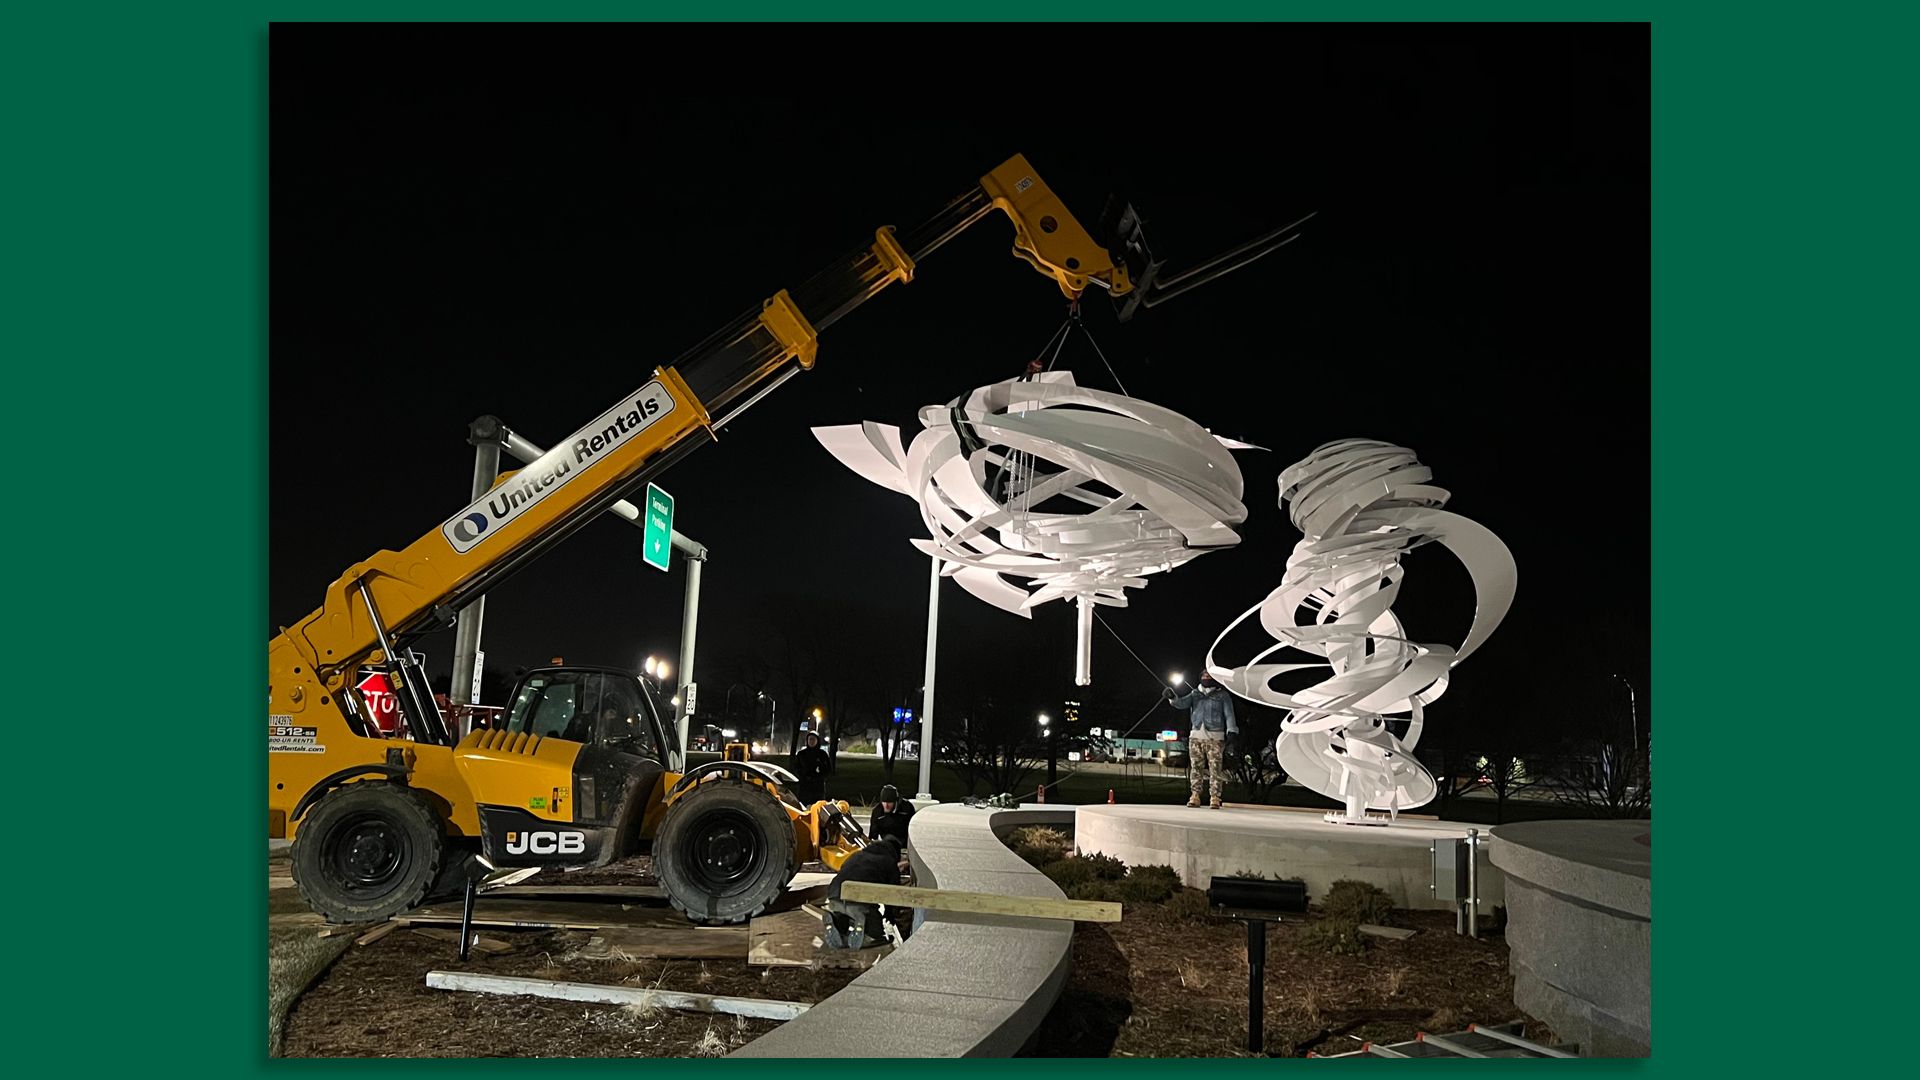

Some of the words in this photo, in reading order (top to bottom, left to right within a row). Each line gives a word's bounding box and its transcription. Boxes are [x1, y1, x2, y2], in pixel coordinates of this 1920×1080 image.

[488, 460, 571, 520] United
[572, 397, 660, 465] Rentals
[652, 496, 669, 516] Terminal
[651, 513, 666, 534] Parking
[506, 831, 585, 855] JCB
